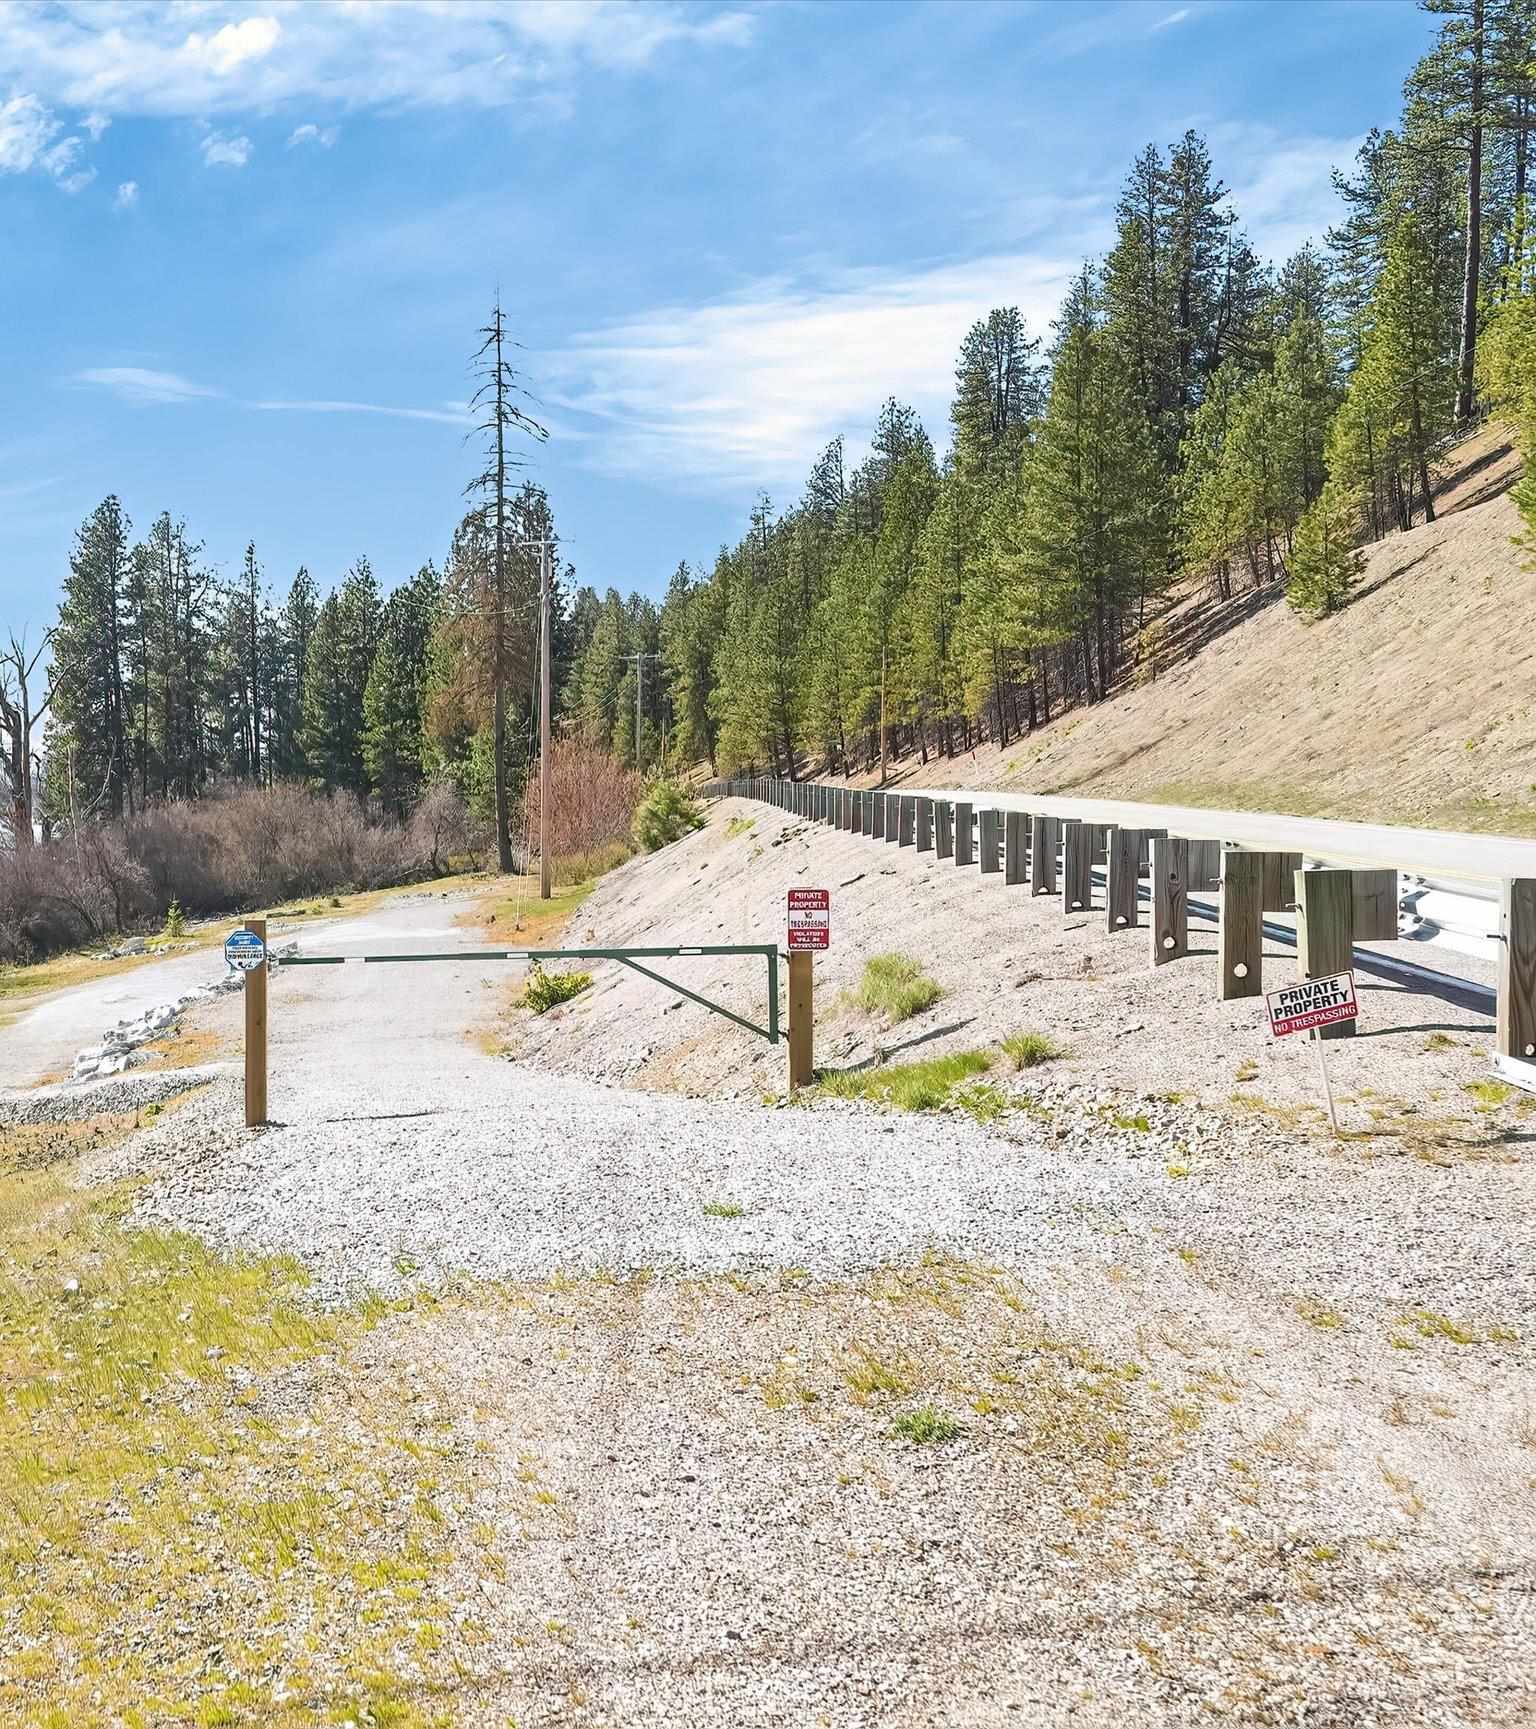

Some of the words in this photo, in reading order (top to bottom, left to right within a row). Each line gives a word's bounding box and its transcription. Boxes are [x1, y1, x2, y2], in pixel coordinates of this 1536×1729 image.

[1273, 989, 1348, 1020] PROPERTY
[1279, 979, 1340, 1005] PRIVATE
[1274, 1022, 1288, 1034] NO
[1291, 1004, 1356, 1028] TRESPASSING
